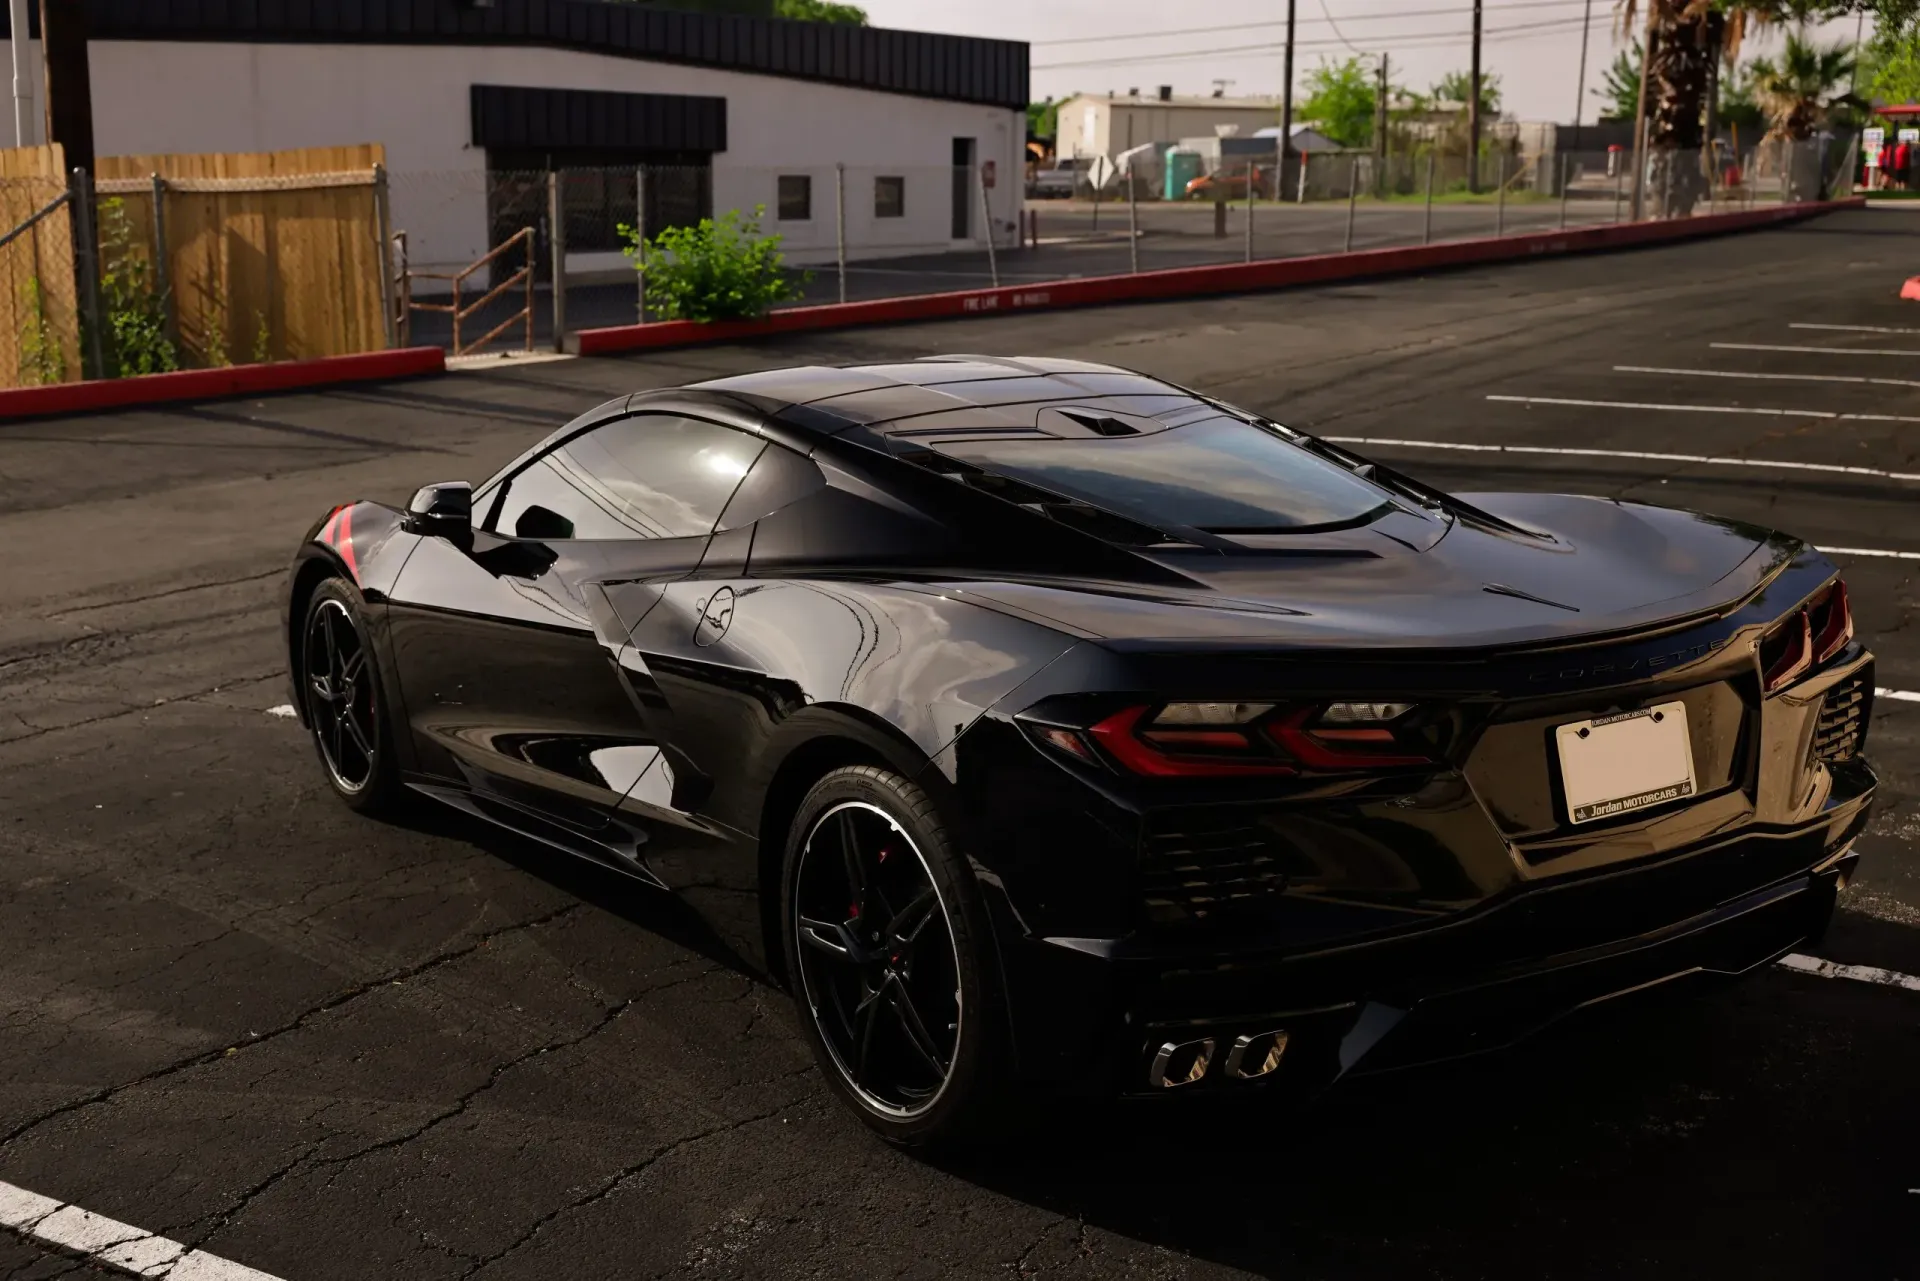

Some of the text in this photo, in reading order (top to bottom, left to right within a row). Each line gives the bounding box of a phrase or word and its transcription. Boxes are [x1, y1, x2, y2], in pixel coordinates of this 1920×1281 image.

[1529, 639, 1725, 681] CORVETTE
[1591, 788, 1677, 817] Jordan MOTORCARS
